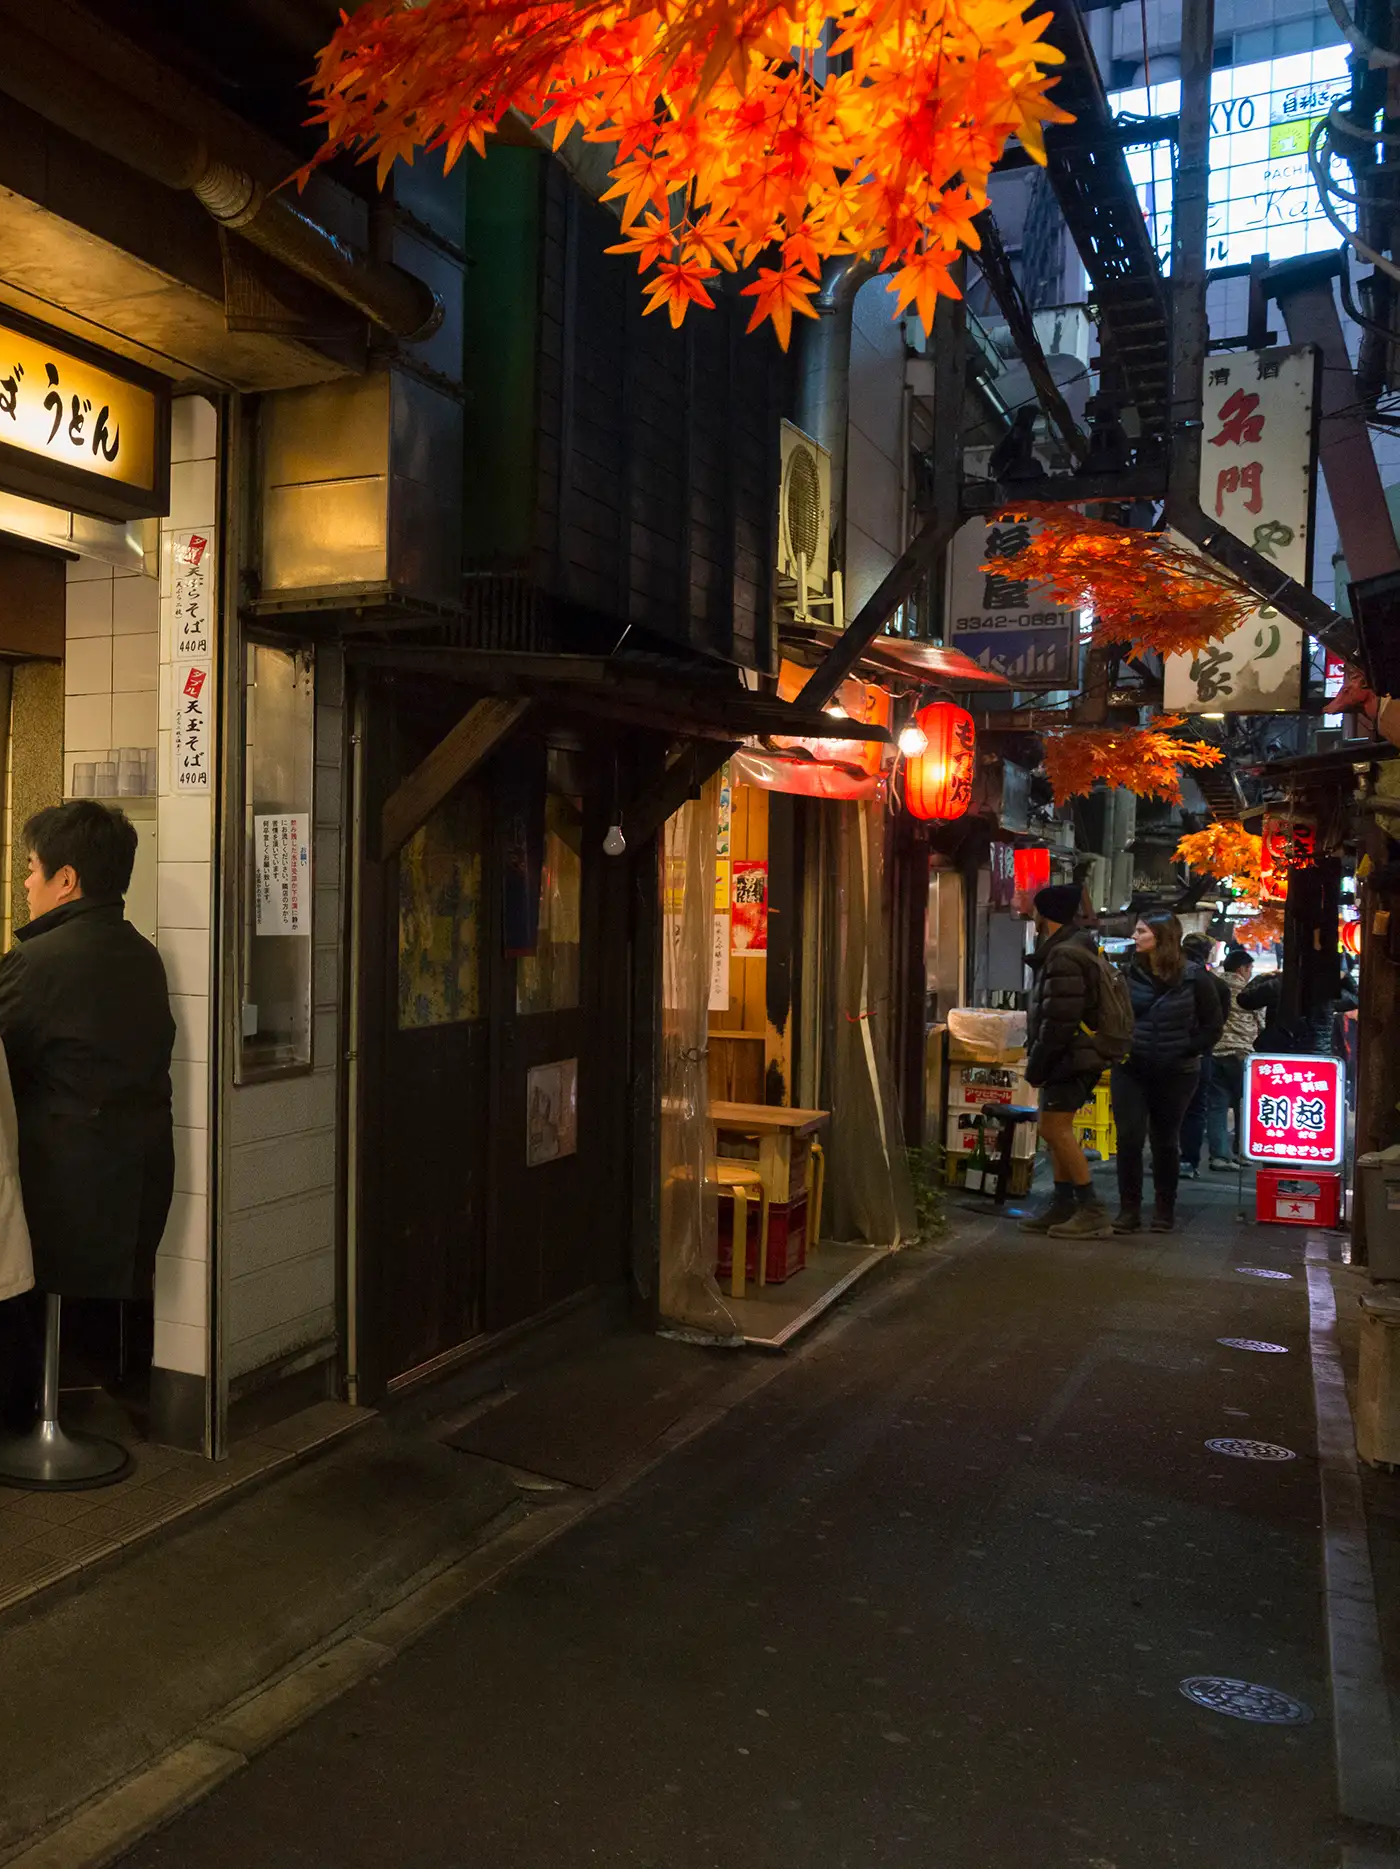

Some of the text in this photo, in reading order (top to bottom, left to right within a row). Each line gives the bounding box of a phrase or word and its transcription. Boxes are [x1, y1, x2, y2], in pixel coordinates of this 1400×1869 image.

[1263, 157, 1342, 181] PACHIO
[1208, 361, 1278, 386] 清酒
[44, 363, 119, 462] うどん
[1208, 388, 1266, 518] 名門
[184, 566, 205, 635] 天ぷらそば
[179, 639, 207, 652] 440円
[184, 700, 204, 768] 天玉そば
[179, 772, 207, 785] 490円
[1270, 1071, 1315, 1085] スタミナ
